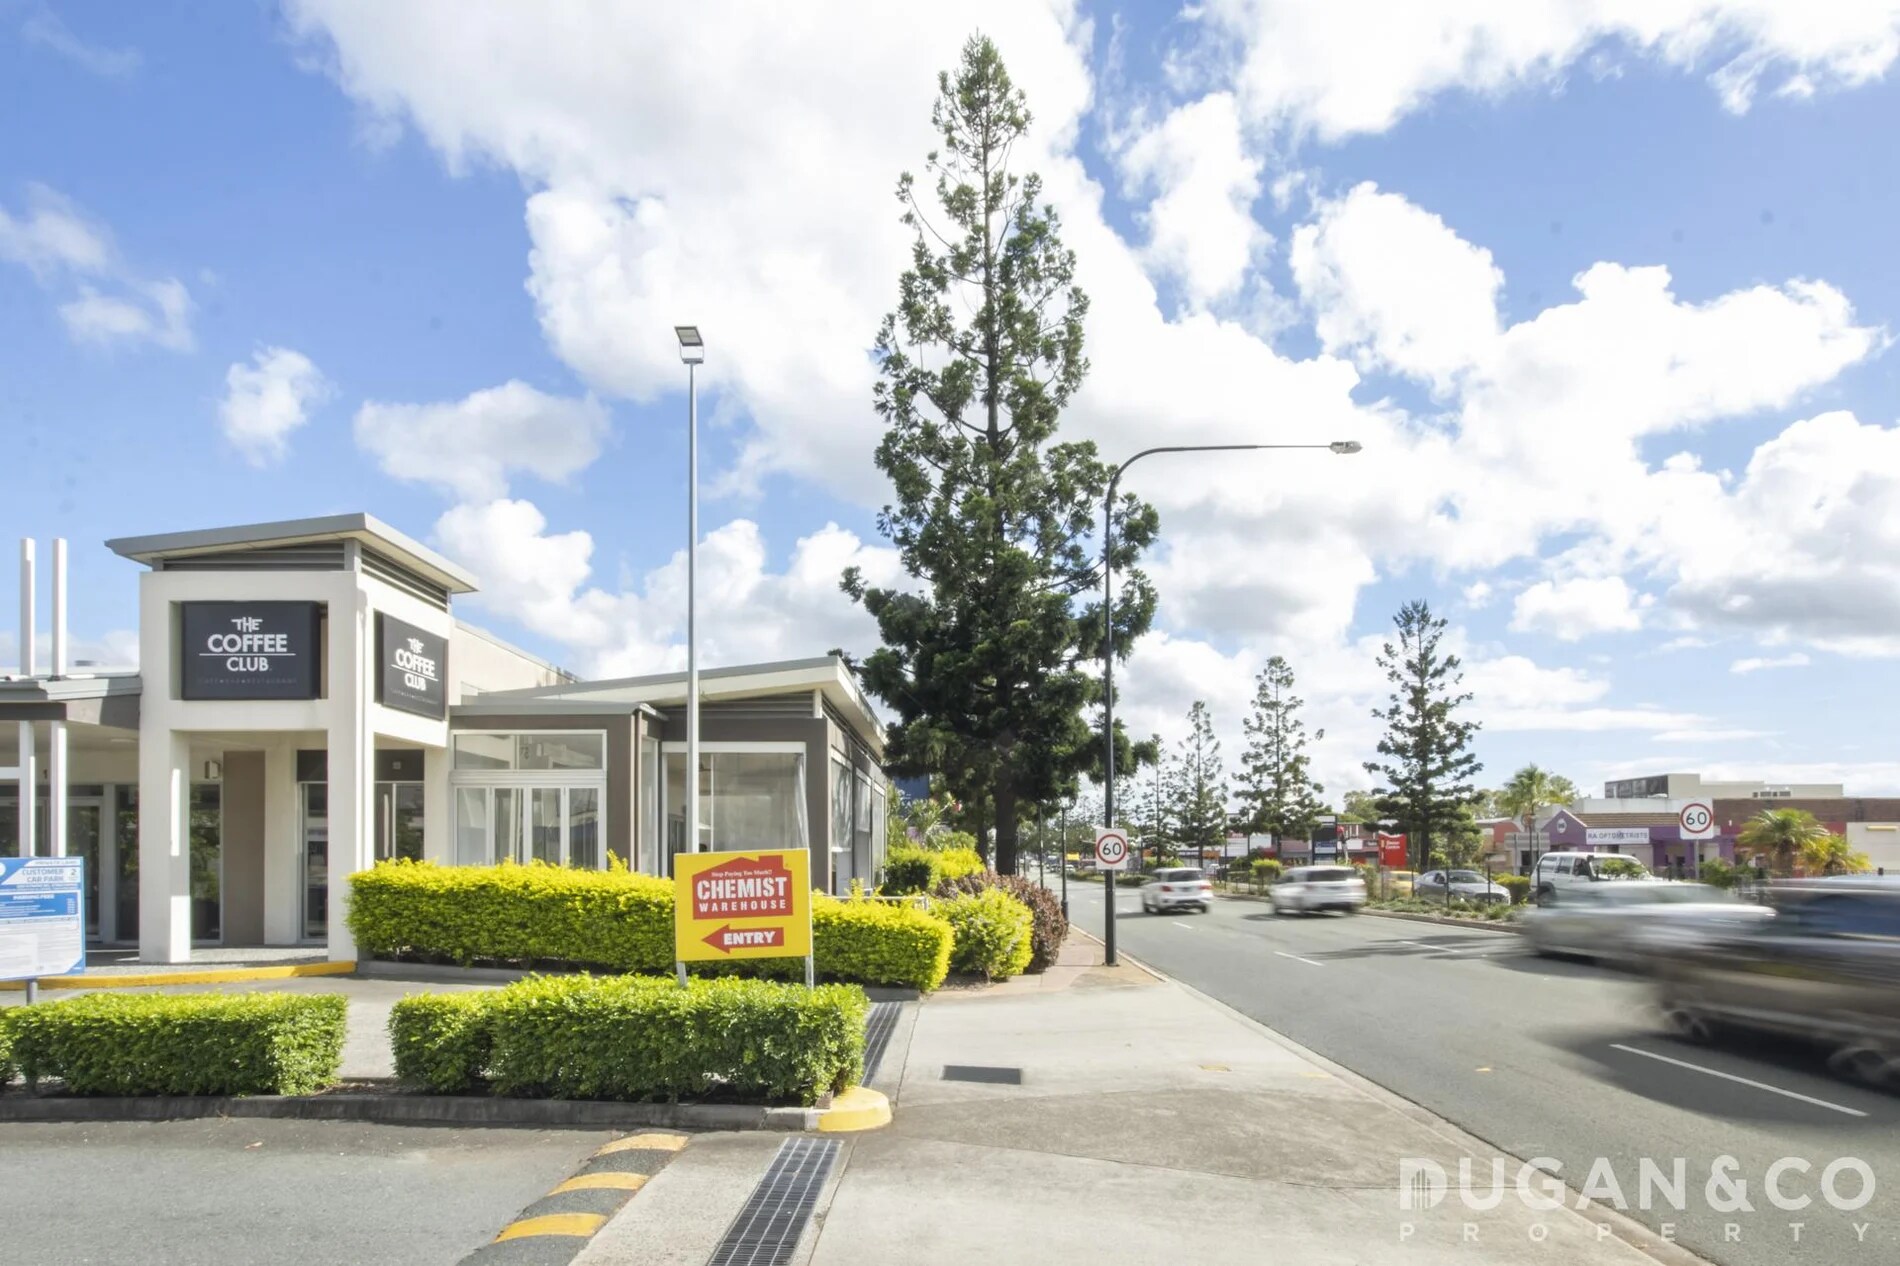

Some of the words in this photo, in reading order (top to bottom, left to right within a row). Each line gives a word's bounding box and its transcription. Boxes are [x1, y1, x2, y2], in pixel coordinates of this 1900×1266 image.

[231, 617, 263, 632] THE
[207, 633, 288, 653] COFFEE
[407, 638, 425, 654] THE
[226, 656, 269, 672] CLUB
[395, 648, 436, 677] COFFEE
[404, 672, 427, 691] CLUB
[1685, 811, 1707, 825] 60
[1102, 842, 1122, 856] 60
[22, 868, 64, 876] CUSTOMER
[697, 877, 787, 900] CHEMIST
[699, 899, 786, 912] WAREHOUSE
[723, 931, 776, 945] ENTRY
